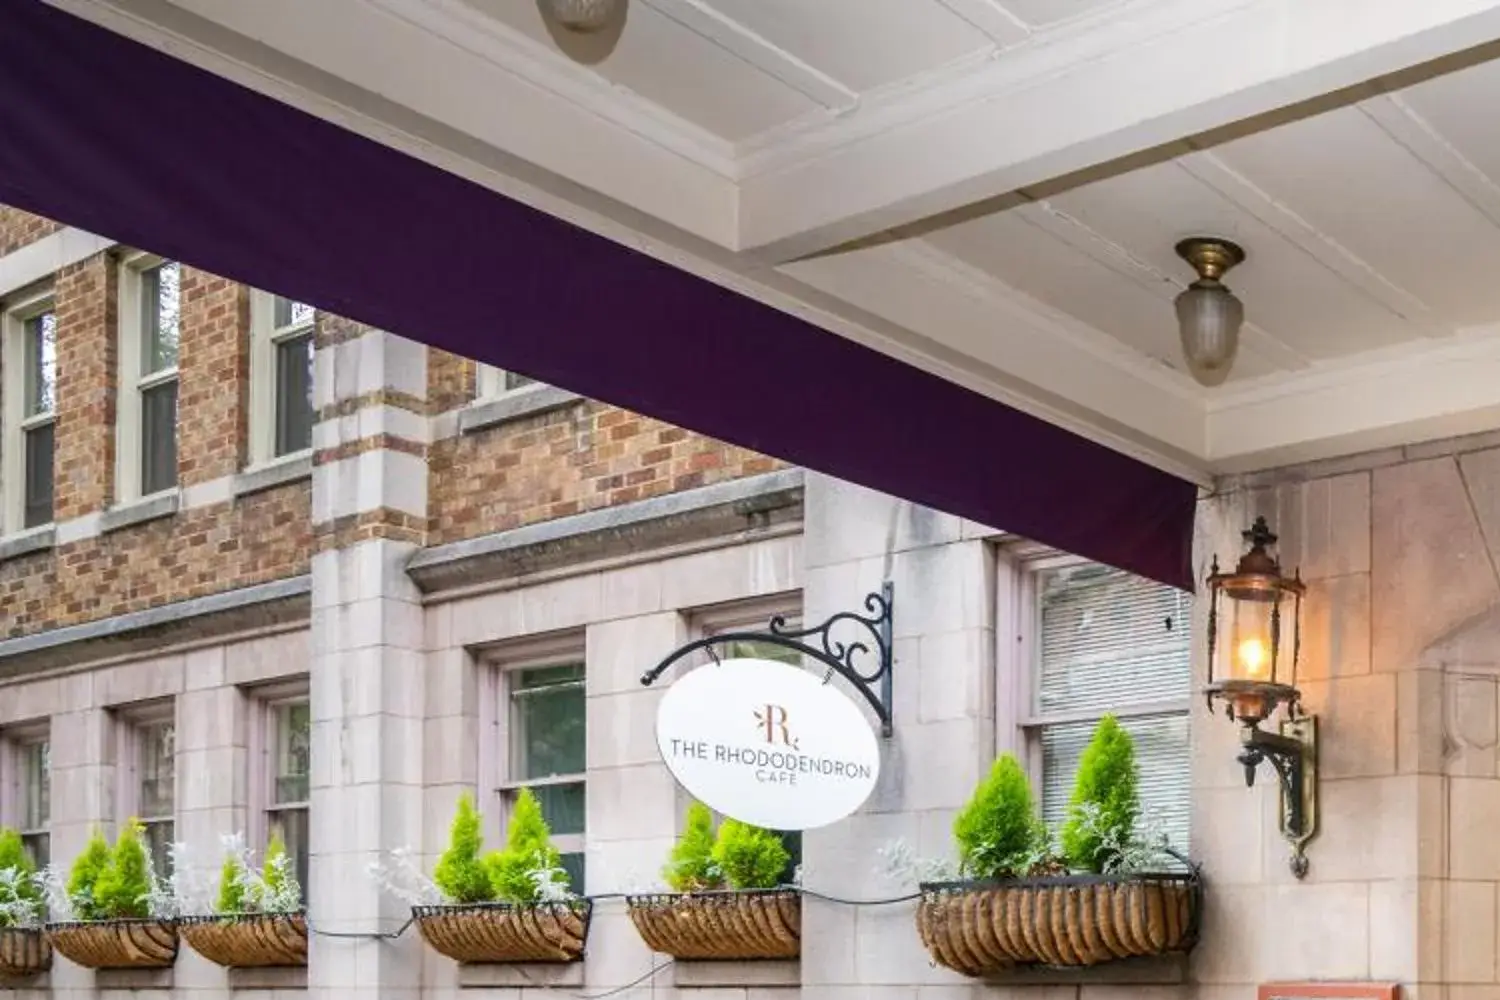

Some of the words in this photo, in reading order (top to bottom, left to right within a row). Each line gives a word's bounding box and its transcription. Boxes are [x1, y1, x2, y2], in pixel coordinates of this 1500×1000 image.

[671, 740, 708, 760] THE
[715, 744, 872, 779] RHODODENDRON
[756, 770, 797, 785] CAFE
